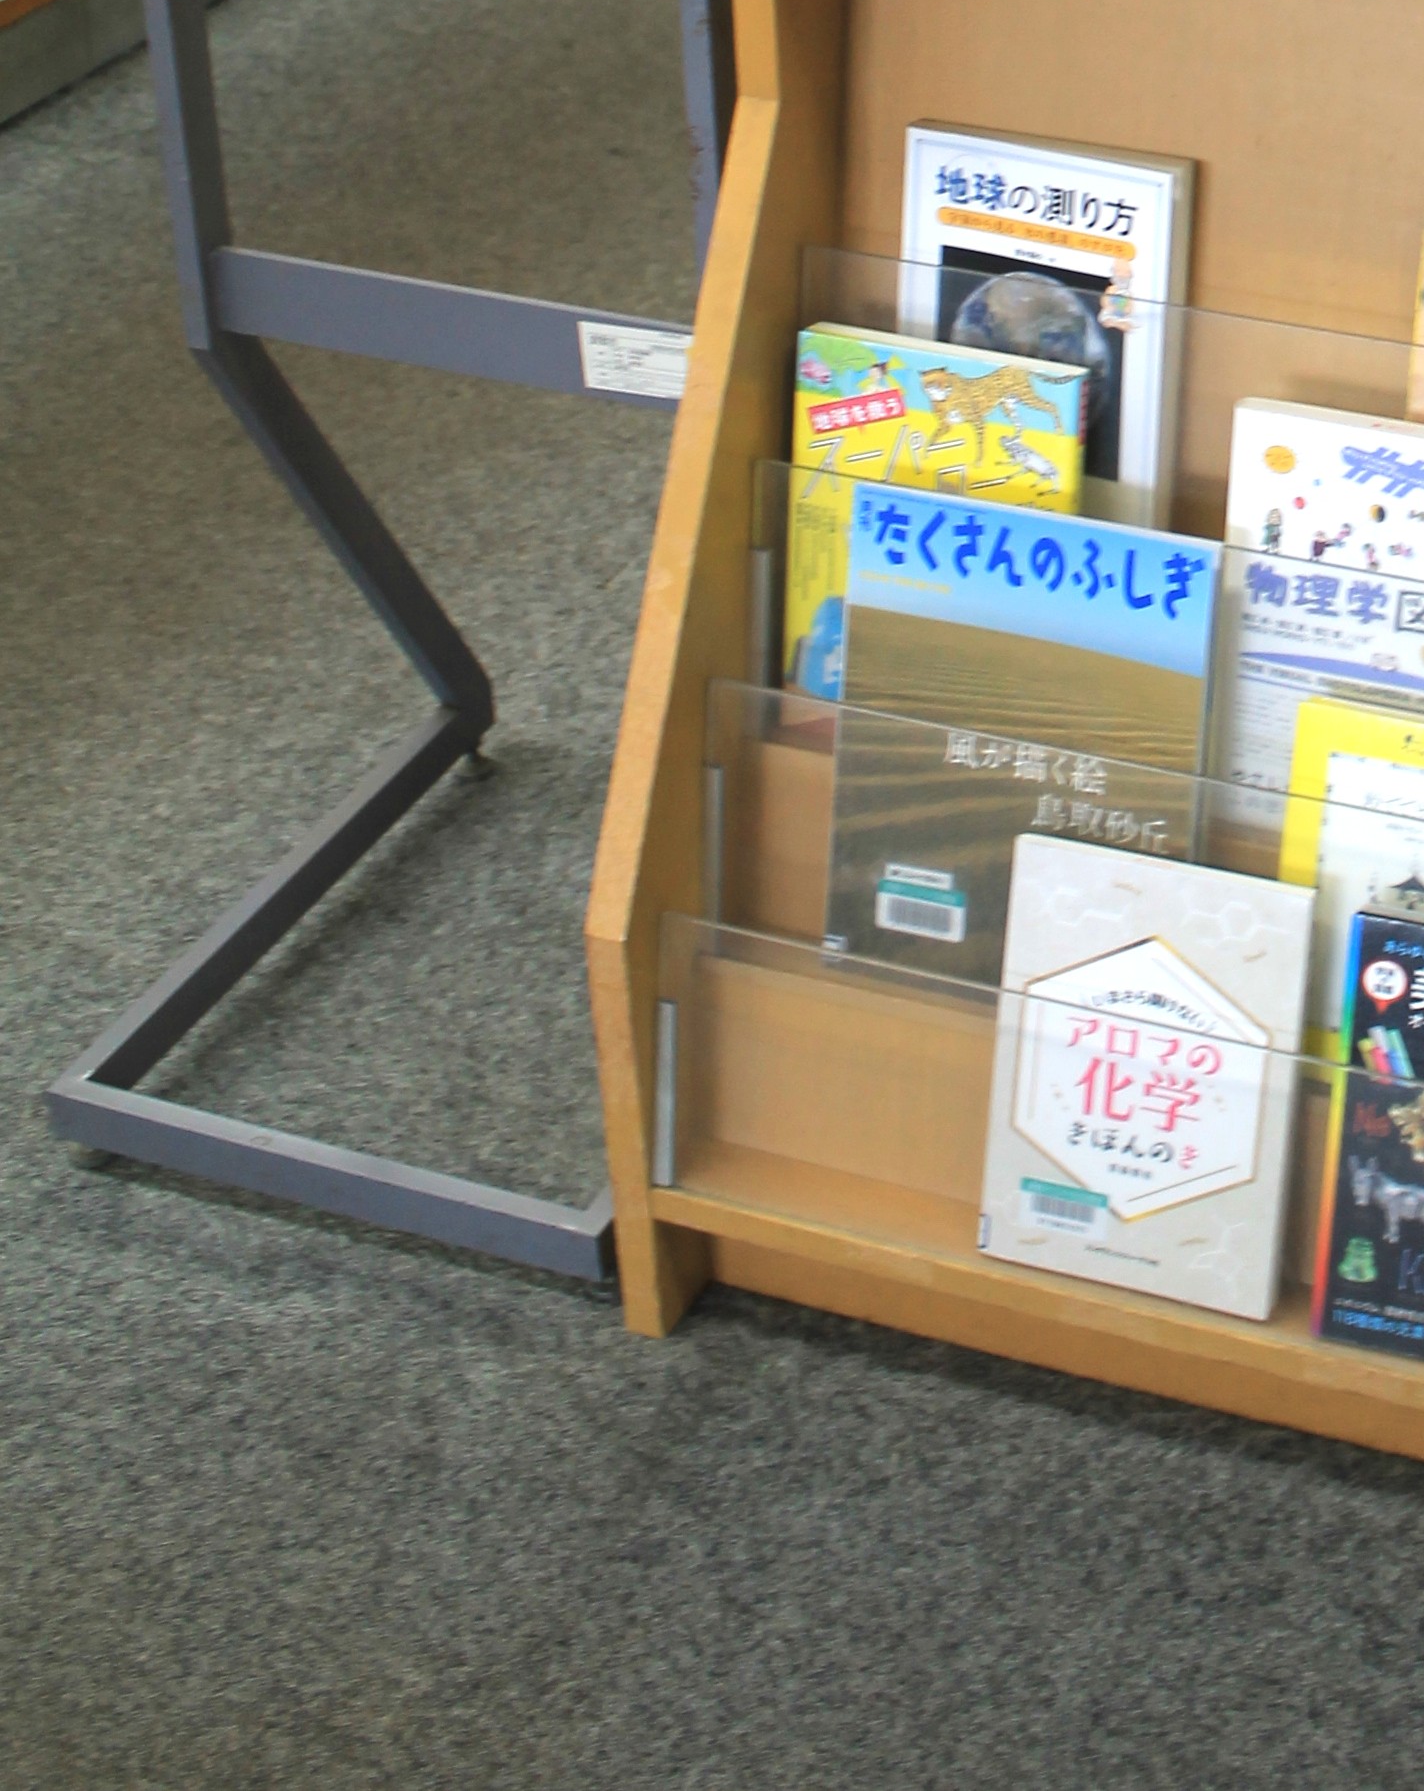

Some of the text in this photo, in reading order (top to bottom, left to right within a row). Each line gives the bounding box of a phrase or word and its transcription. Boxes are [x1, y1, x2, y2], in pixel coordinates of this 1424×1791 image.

[935, 163, 1139, 237] 地球の測り方
[873, 503, 1207, 620] たくさんのふしぎ
[943, 733, 1108, 796] 風が描く絵
[1030, 793, 1169, 855] 鳥取砂丘
[1066, 1015, 1223, 1077] アロマの
[1075, 1058, 1202, 1132] 化学
[1067, 1123, 1200, 1169] きほんのき
